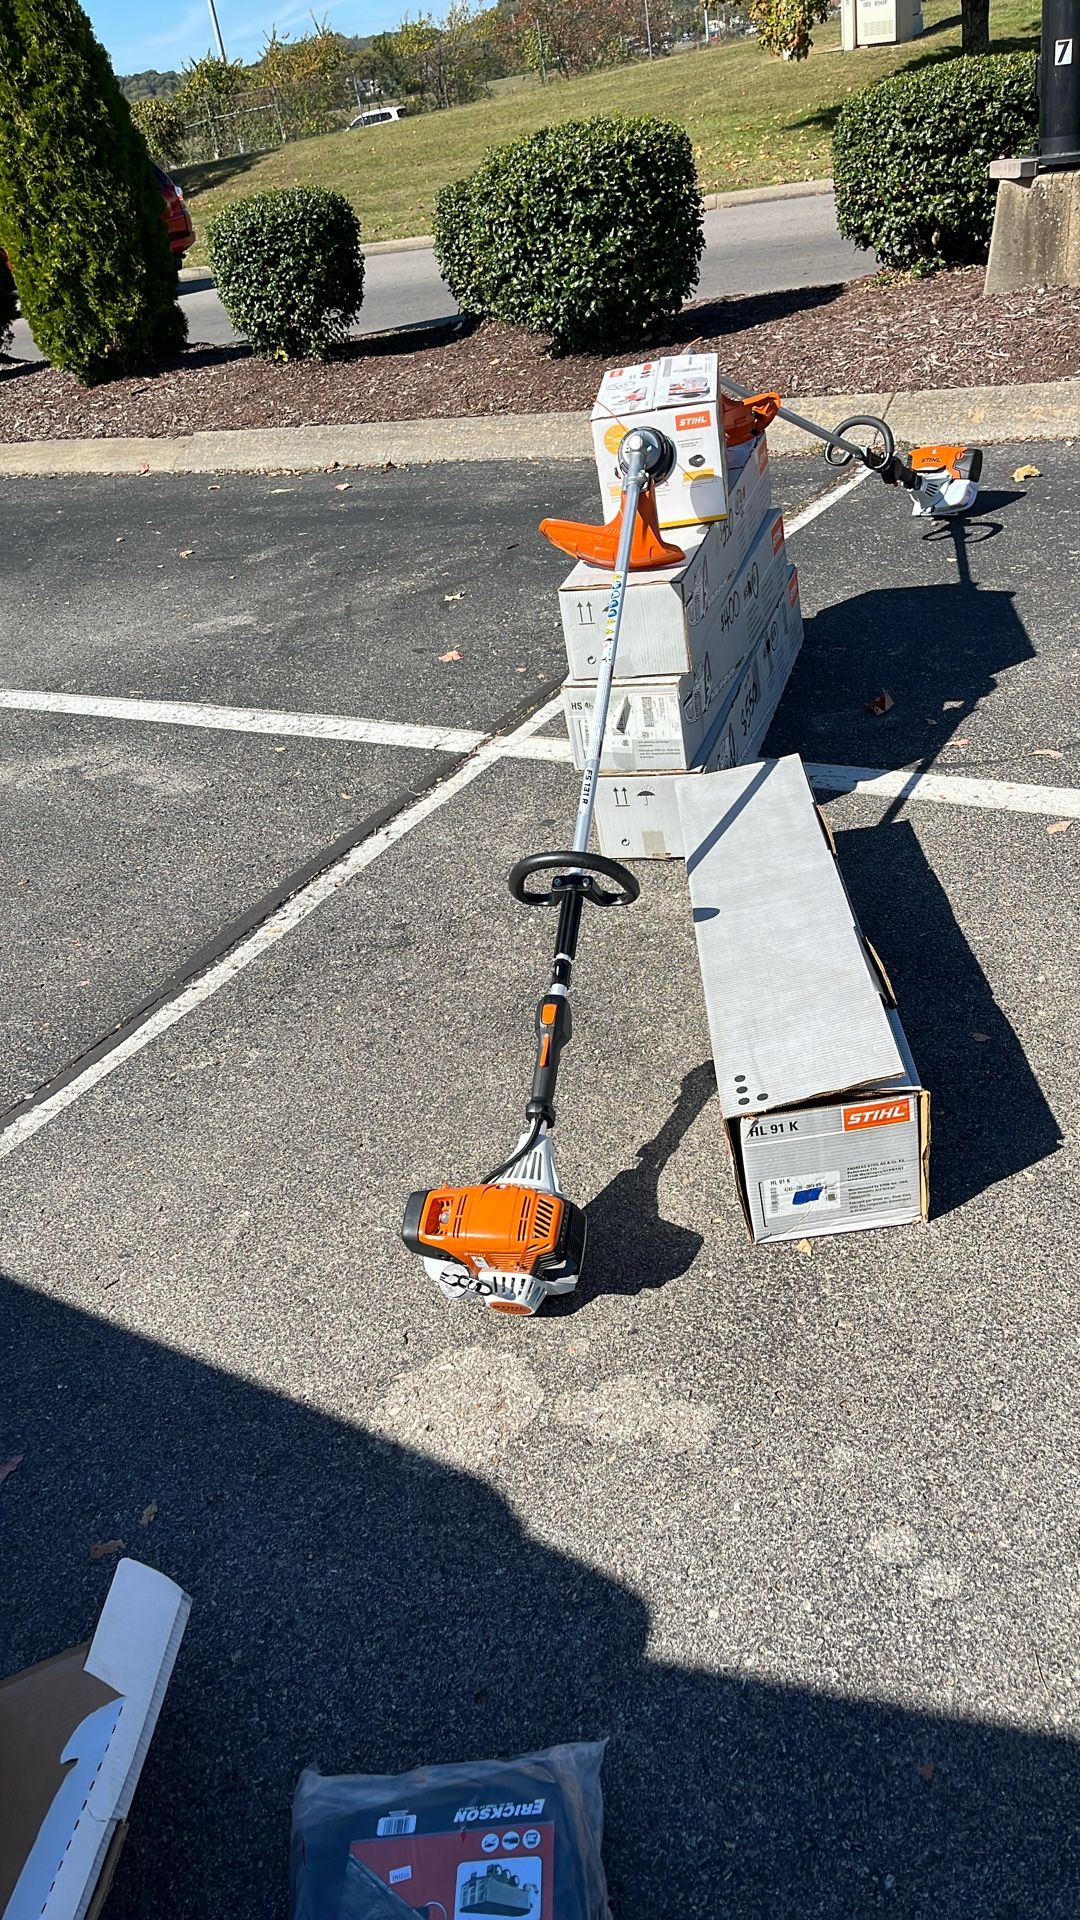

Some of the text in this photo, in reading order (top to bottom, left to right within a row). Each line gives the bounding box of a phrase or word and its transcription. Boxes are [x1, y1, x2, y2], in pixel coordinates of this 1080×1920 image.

[1058, 41, 1070, 63] 7
[679, 416, 707, 427] STIHL
[571, 702, 583, 710] HS
[585, 769, 593, 780] FS
[583, 782, 592, 796] 131
[849, 1106, 906, 1124] STIHL
[750, 1121, 799, 1137] HL 91 K
[453, 1798, 546, 1824] ERICKSON
